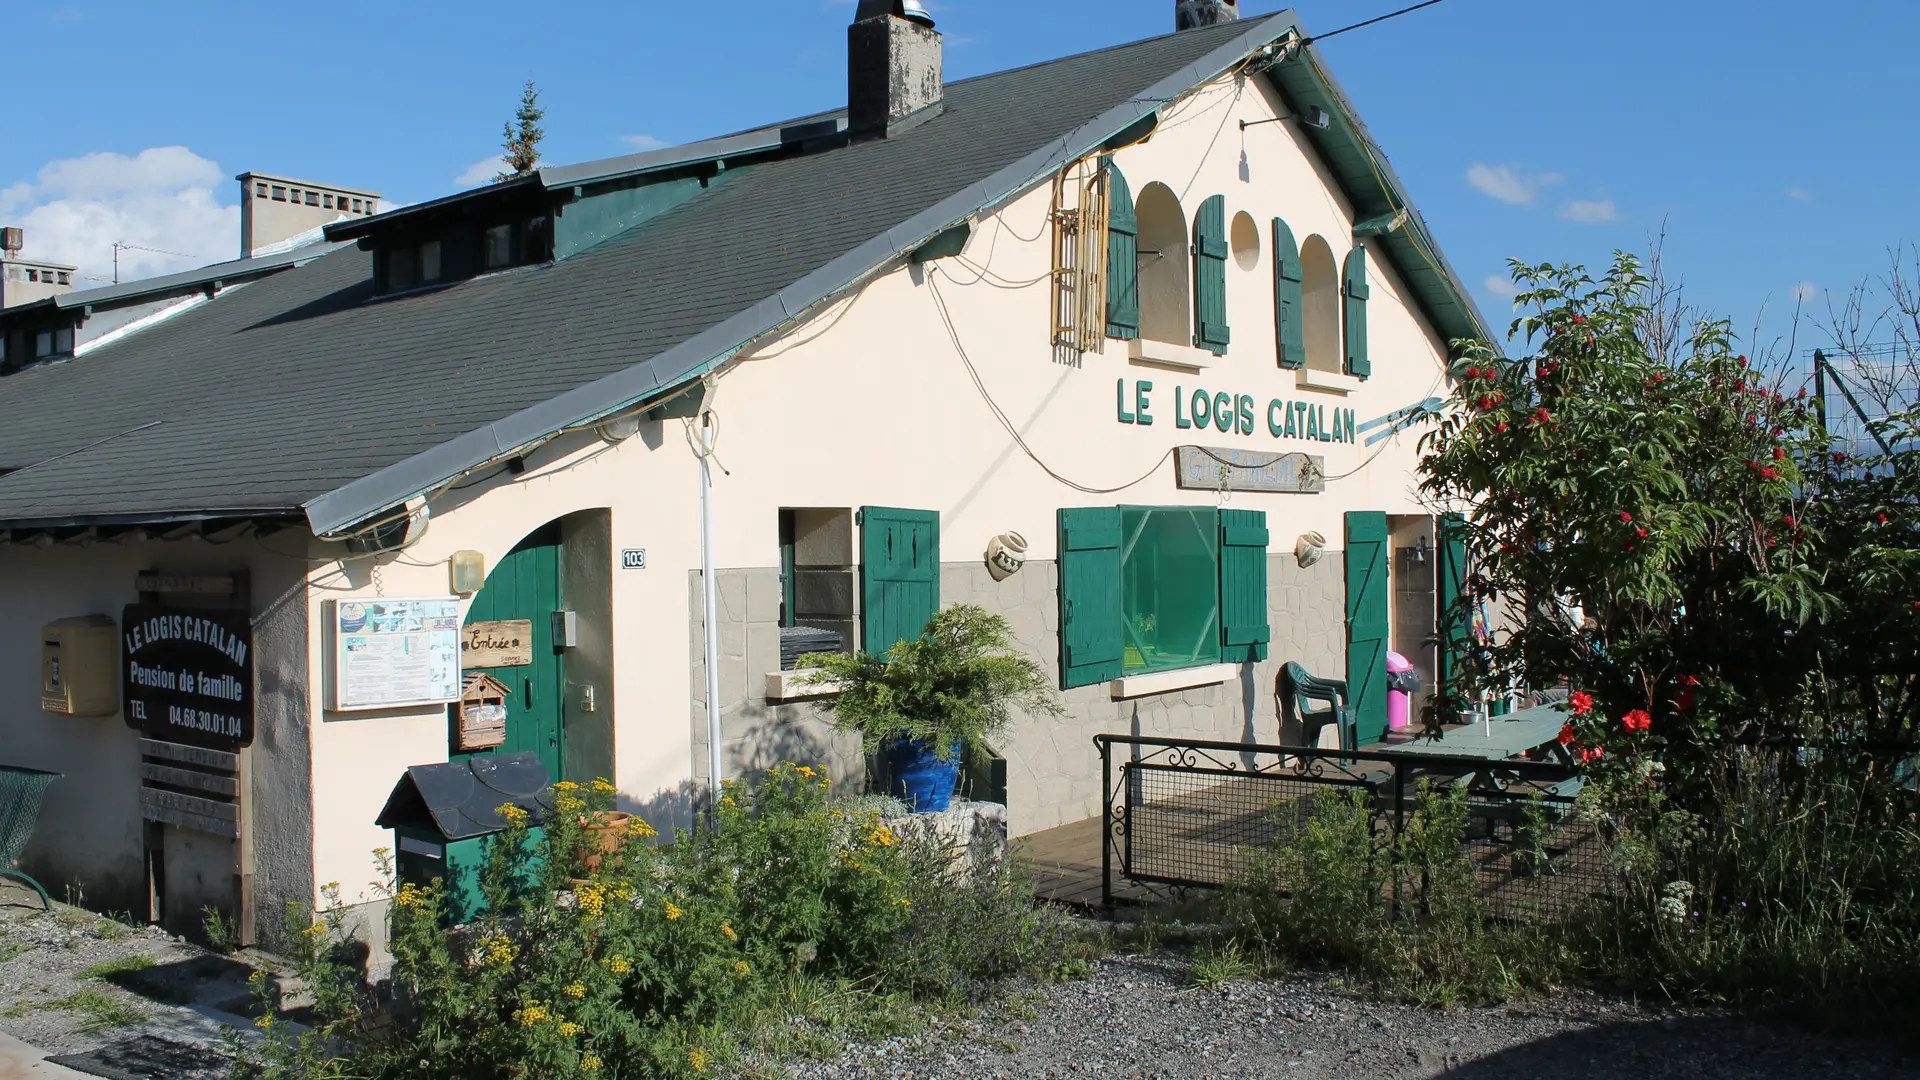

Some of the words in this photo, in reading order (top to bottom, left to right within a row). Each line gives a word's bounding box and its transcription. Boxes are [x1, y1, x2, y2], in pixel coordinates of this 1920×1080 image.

[1117, 378, 1153, 426] LE
[1175, 385, 1255, 436] LOGIS
[1267, 398, 1356, 444] CATALAN
[624, 552, 644, 567] 103
[126, 629, 143, 655] LE
[144, 615, 182, 643] LOGIS
[184, 615, 248, 668] CATALAN
[471, 629, 510, 650] Entrée
[130, 661, 176, 690] Pension
[179, 671, 195, 693] de
[198, 673, 243, 702] famille
[131, 700, 147, 720] TEL
[169, 706, 242, 738] 04.68.30.01.04
